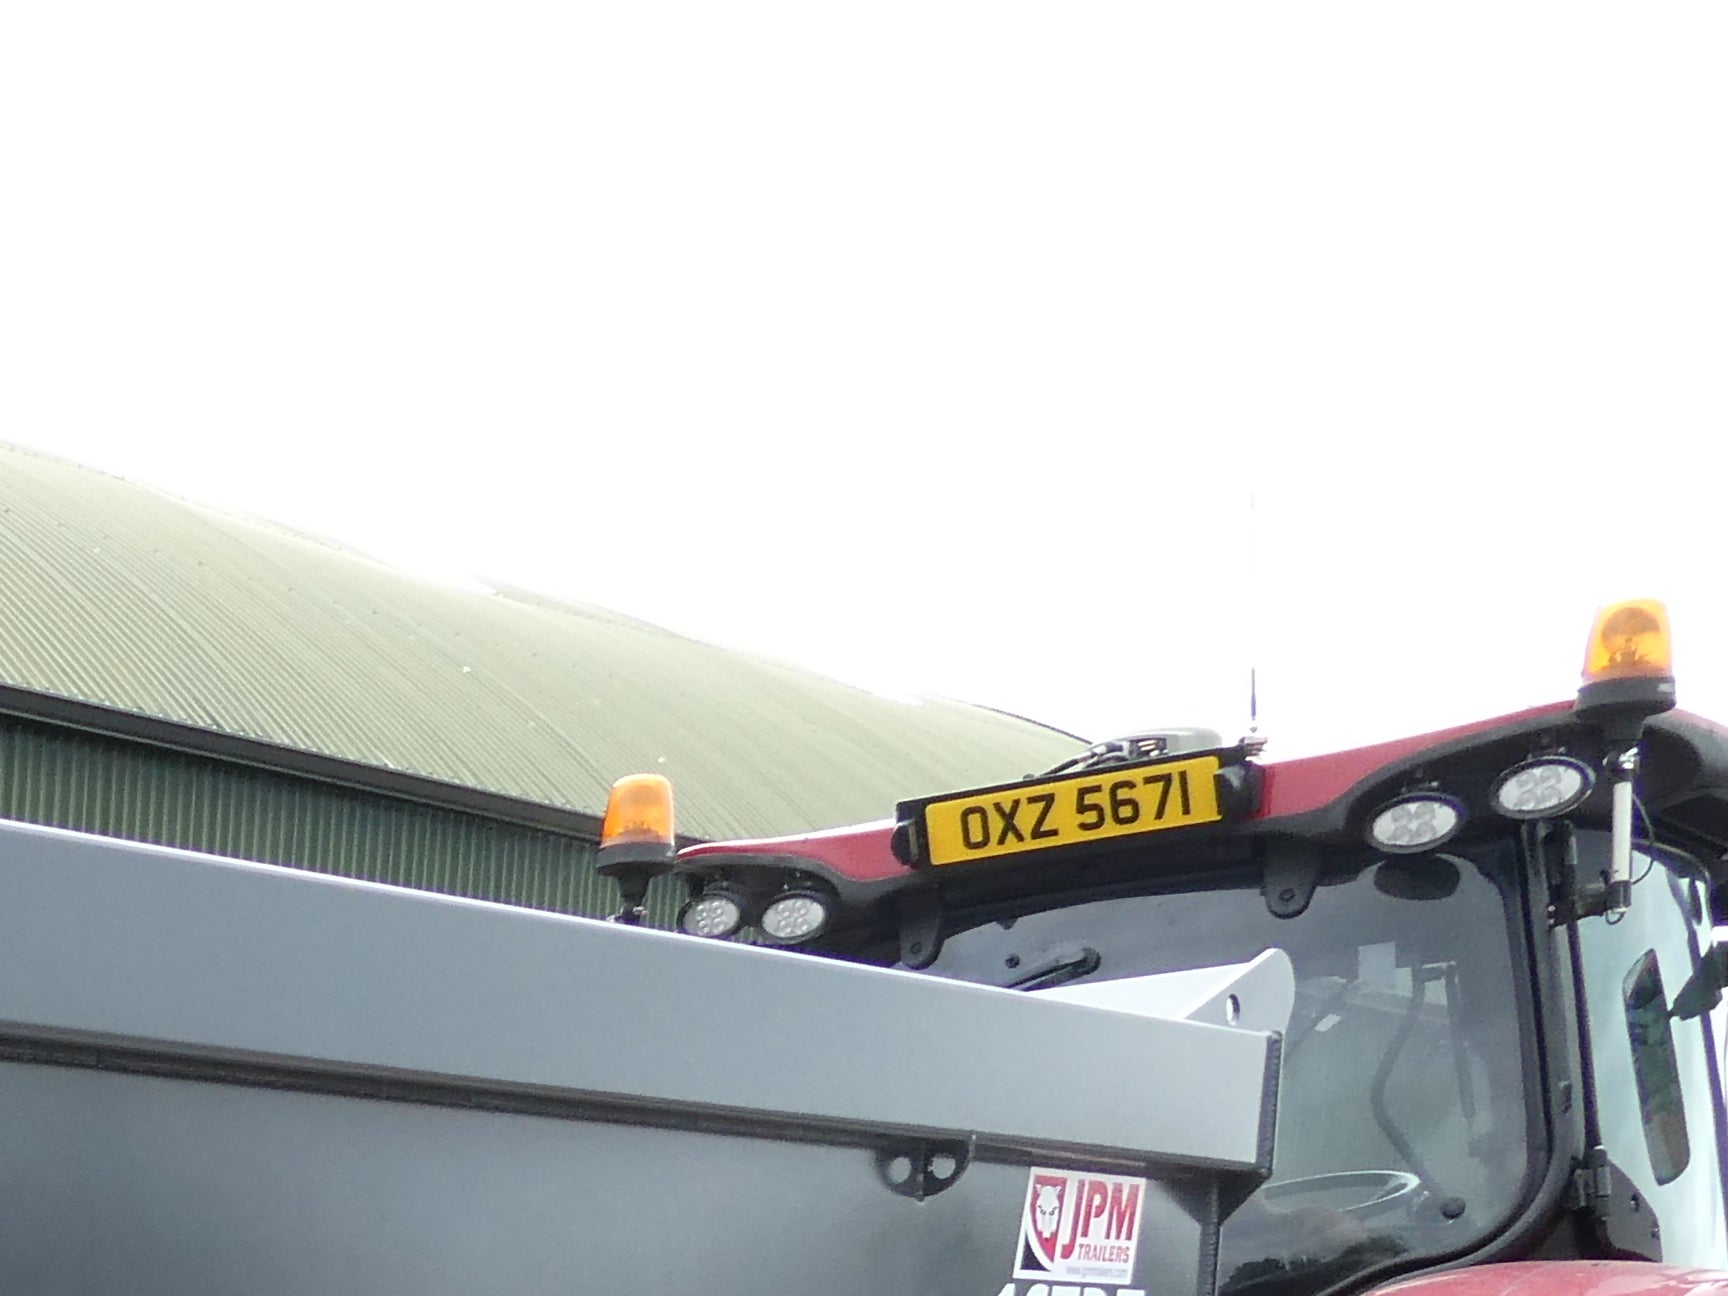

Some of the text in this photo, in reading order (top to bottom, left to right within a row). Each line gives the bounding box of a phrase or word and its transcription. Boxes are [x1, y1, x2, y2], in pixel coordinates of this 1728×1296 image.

[960, 770, 1191, 850] OXZ 5671
[1060, 1179, 1140, 1259] JPM
[1078, 1243, 1129, 1263] TRAILERS
